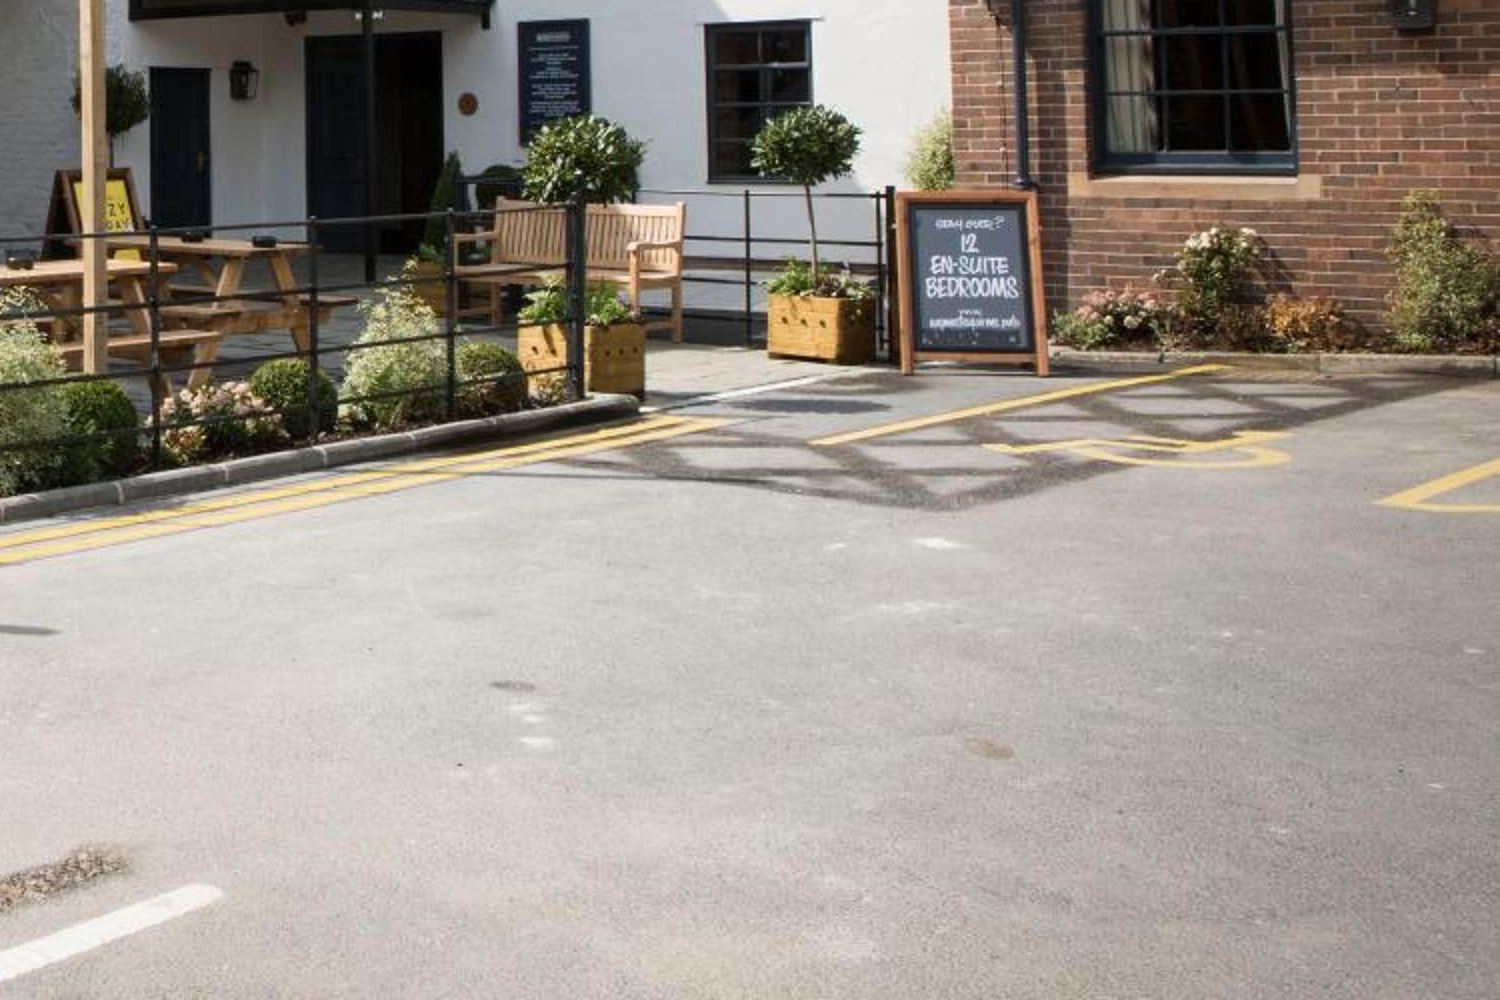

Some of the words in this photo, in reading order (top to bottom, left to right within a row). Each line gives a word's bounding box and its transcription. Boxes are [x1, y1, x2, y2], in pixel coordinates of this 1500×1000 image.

[961, 232, 980, 254] 12
[930, 255, 1009, 275] EN-SUITE
[925, 276, 1020, 299] BEDROOMS
